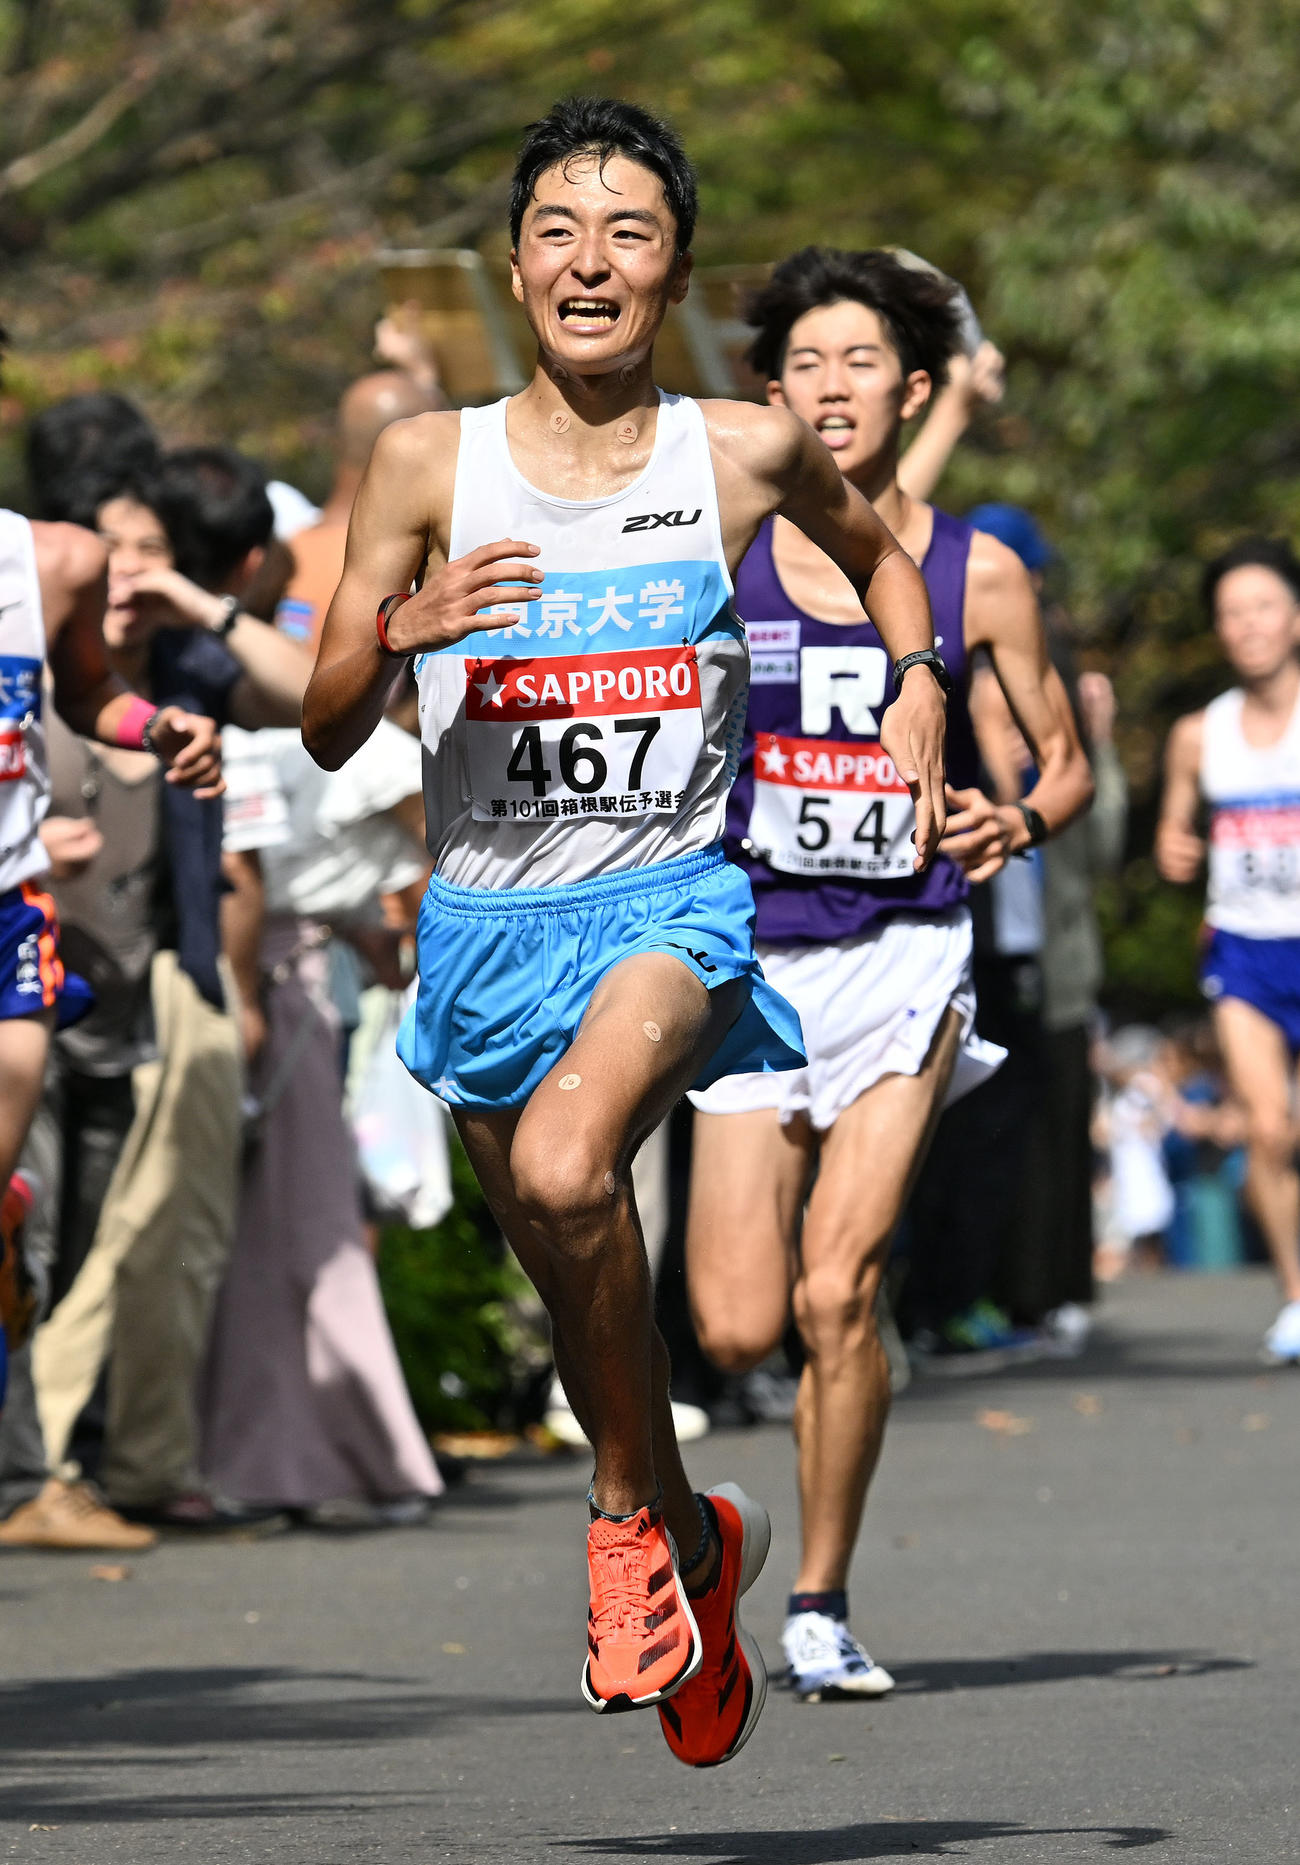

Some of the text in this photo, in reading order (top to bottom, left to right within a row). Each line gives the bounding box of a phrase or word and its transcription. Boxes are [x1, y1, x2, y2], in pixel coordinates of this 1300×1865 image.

[621, 509, 702, 534] 2XU
[515, 662, 692, 709] SAPPORO
[801, 646, 888, 736] R
[506, 716, 662, 798] 467
[793, 750, 906, 788] SAPPO
